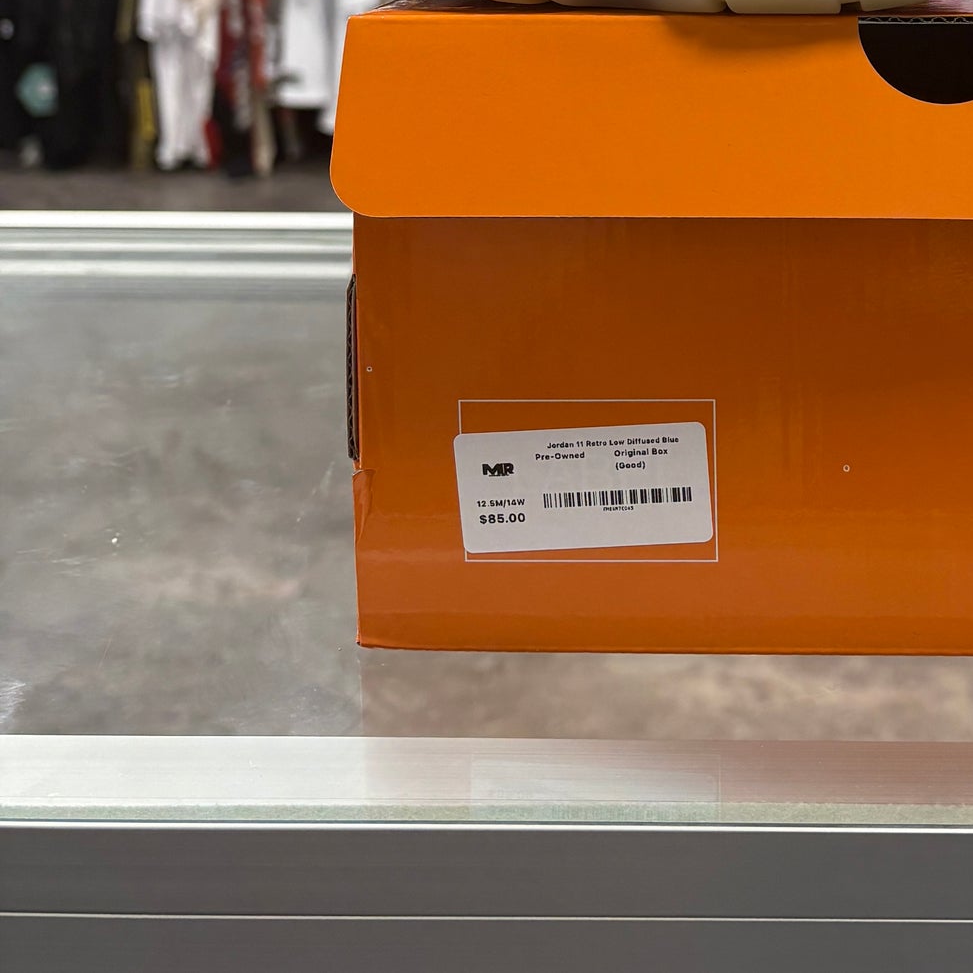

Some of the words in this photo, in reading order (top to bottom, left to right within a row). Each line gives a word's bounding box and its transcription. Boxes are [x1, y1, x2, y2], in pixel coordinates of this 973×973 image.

[546, 441, 575, 449] Jordan
[576, 440, 584, 448] 11
[585, 439, 608, 448] Retro
[608, 439, 625, 447] Low
[626, 436, 661, 446] Diffused
[661, 436, 680, 444] Blue
[534, 451, 586, 461] Pre-Owned
[613, 447, 650, 458] Original
[651, 447, 669, 456] Box
[615, 460, 646, 471] (Good)
[476, 498, 526, 509] 12.5M/14W
[478, 512, 527, 525] $85.00
